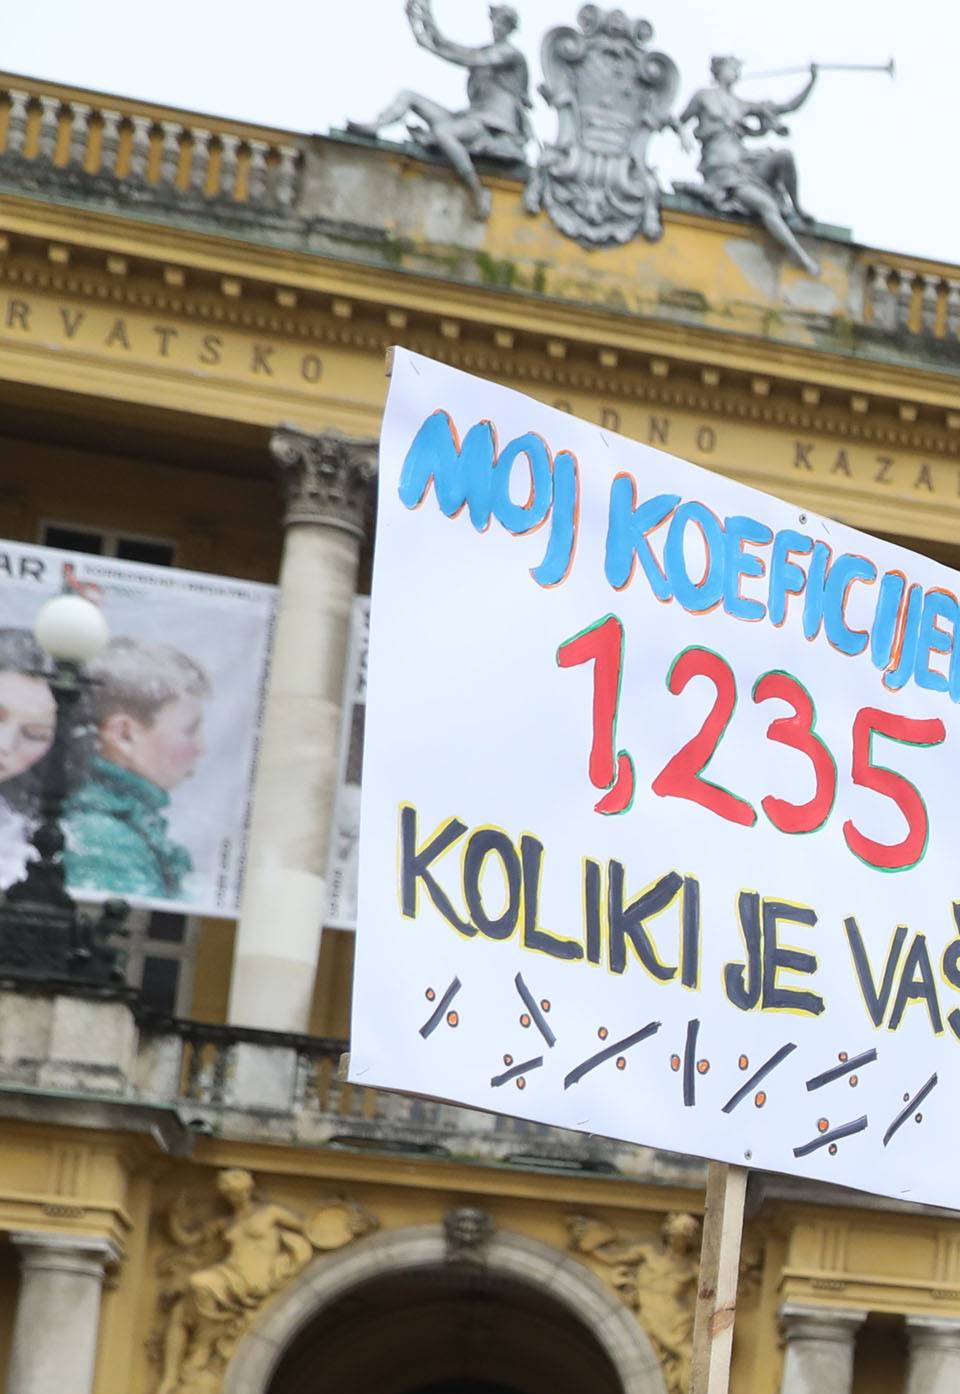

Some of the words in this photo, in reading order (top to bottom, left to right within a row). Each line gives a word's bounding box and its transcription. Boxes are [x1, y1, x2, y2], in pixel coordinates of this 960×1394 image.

[4, 300, 324, 384] RVATSKO
[398, 408, 582, 588] MOJ
[556, 613, 945, 872] 1,235
[399, 801, 700, 990] KOLIKI
[721, 889, 826, 1016] JE
